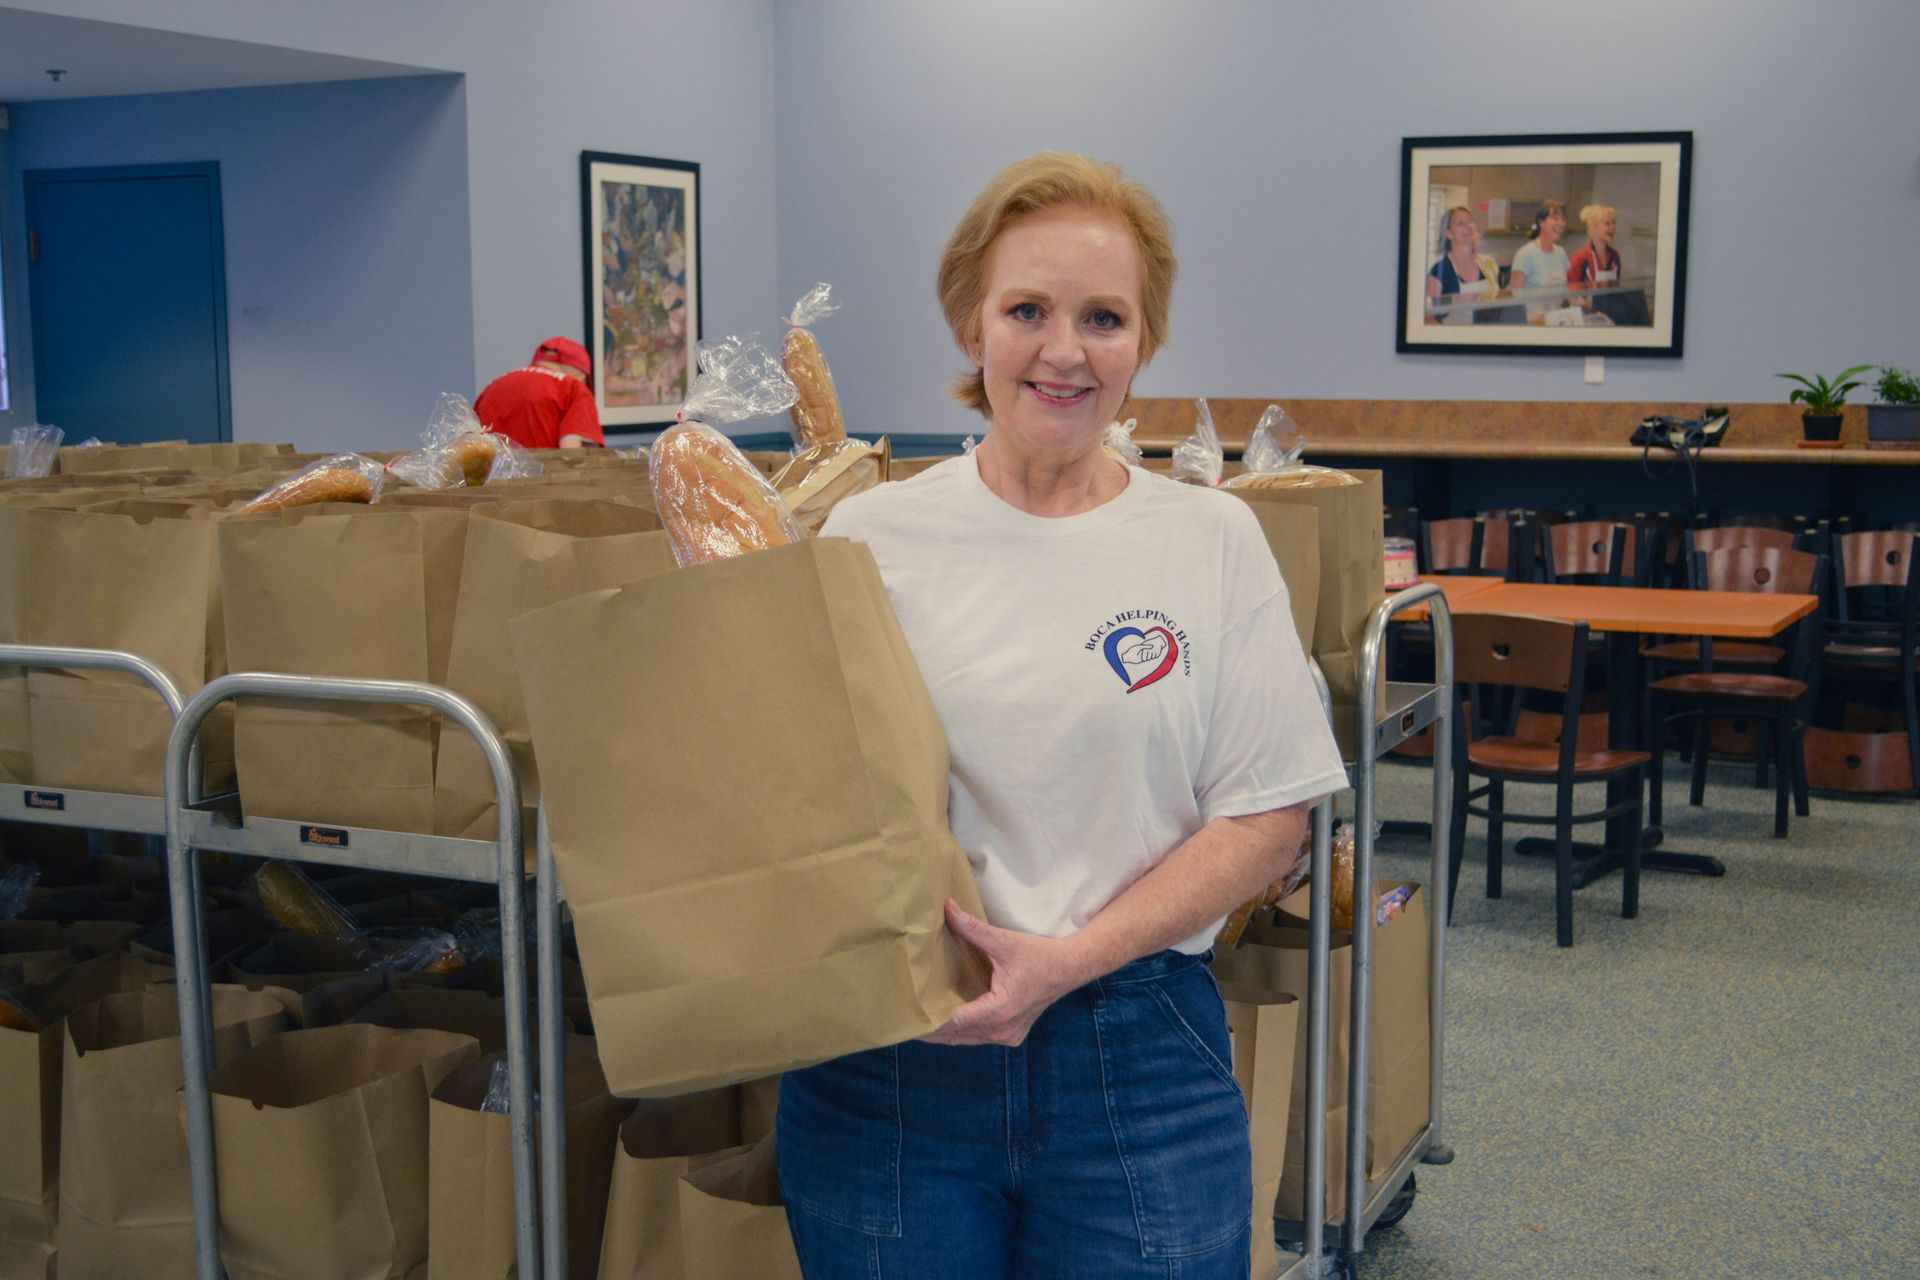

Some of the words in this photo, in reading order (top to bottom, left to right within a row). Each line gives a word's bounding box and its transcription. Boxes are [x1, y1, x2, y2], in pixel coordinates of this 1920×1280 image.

[1085, 621, 1115, 651] BOCA
[1115, 610, 1177, 630] HELPING
[1175, 630, 1191, 677] HANDS
